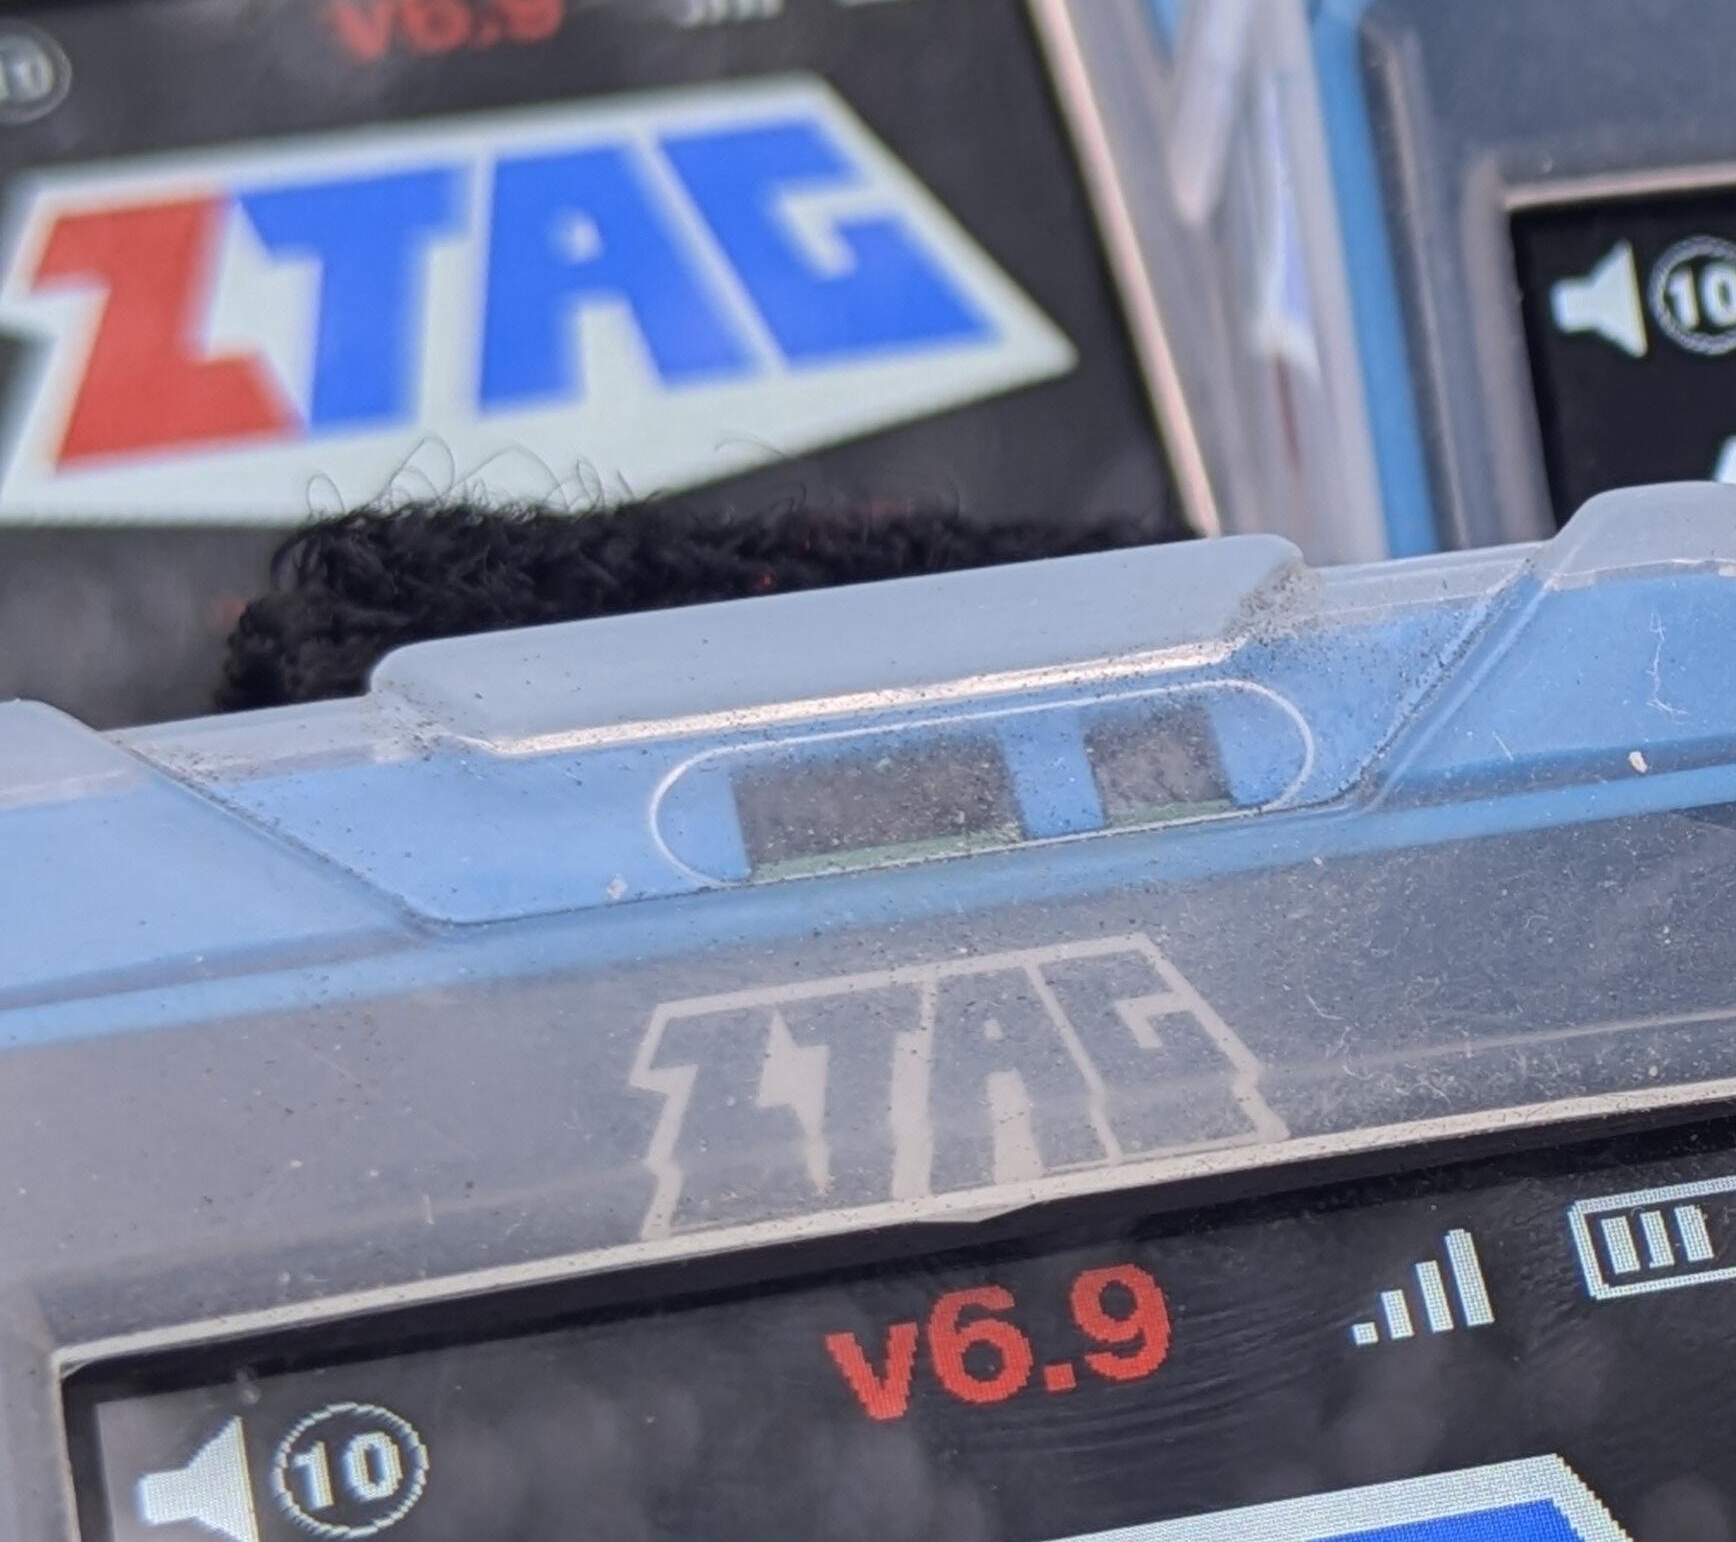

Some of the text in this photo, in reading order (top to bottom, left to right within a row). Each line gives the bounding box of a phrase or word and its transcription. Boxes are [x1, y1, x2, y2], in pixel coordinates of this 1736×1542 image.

[24, 113, 1000, 471] ZTAG
[632, 931, 1282, 1241] ZTAG
[825, 1263, 1173, 1422] v6.9
[288, 1429, 402, 1511] 10
